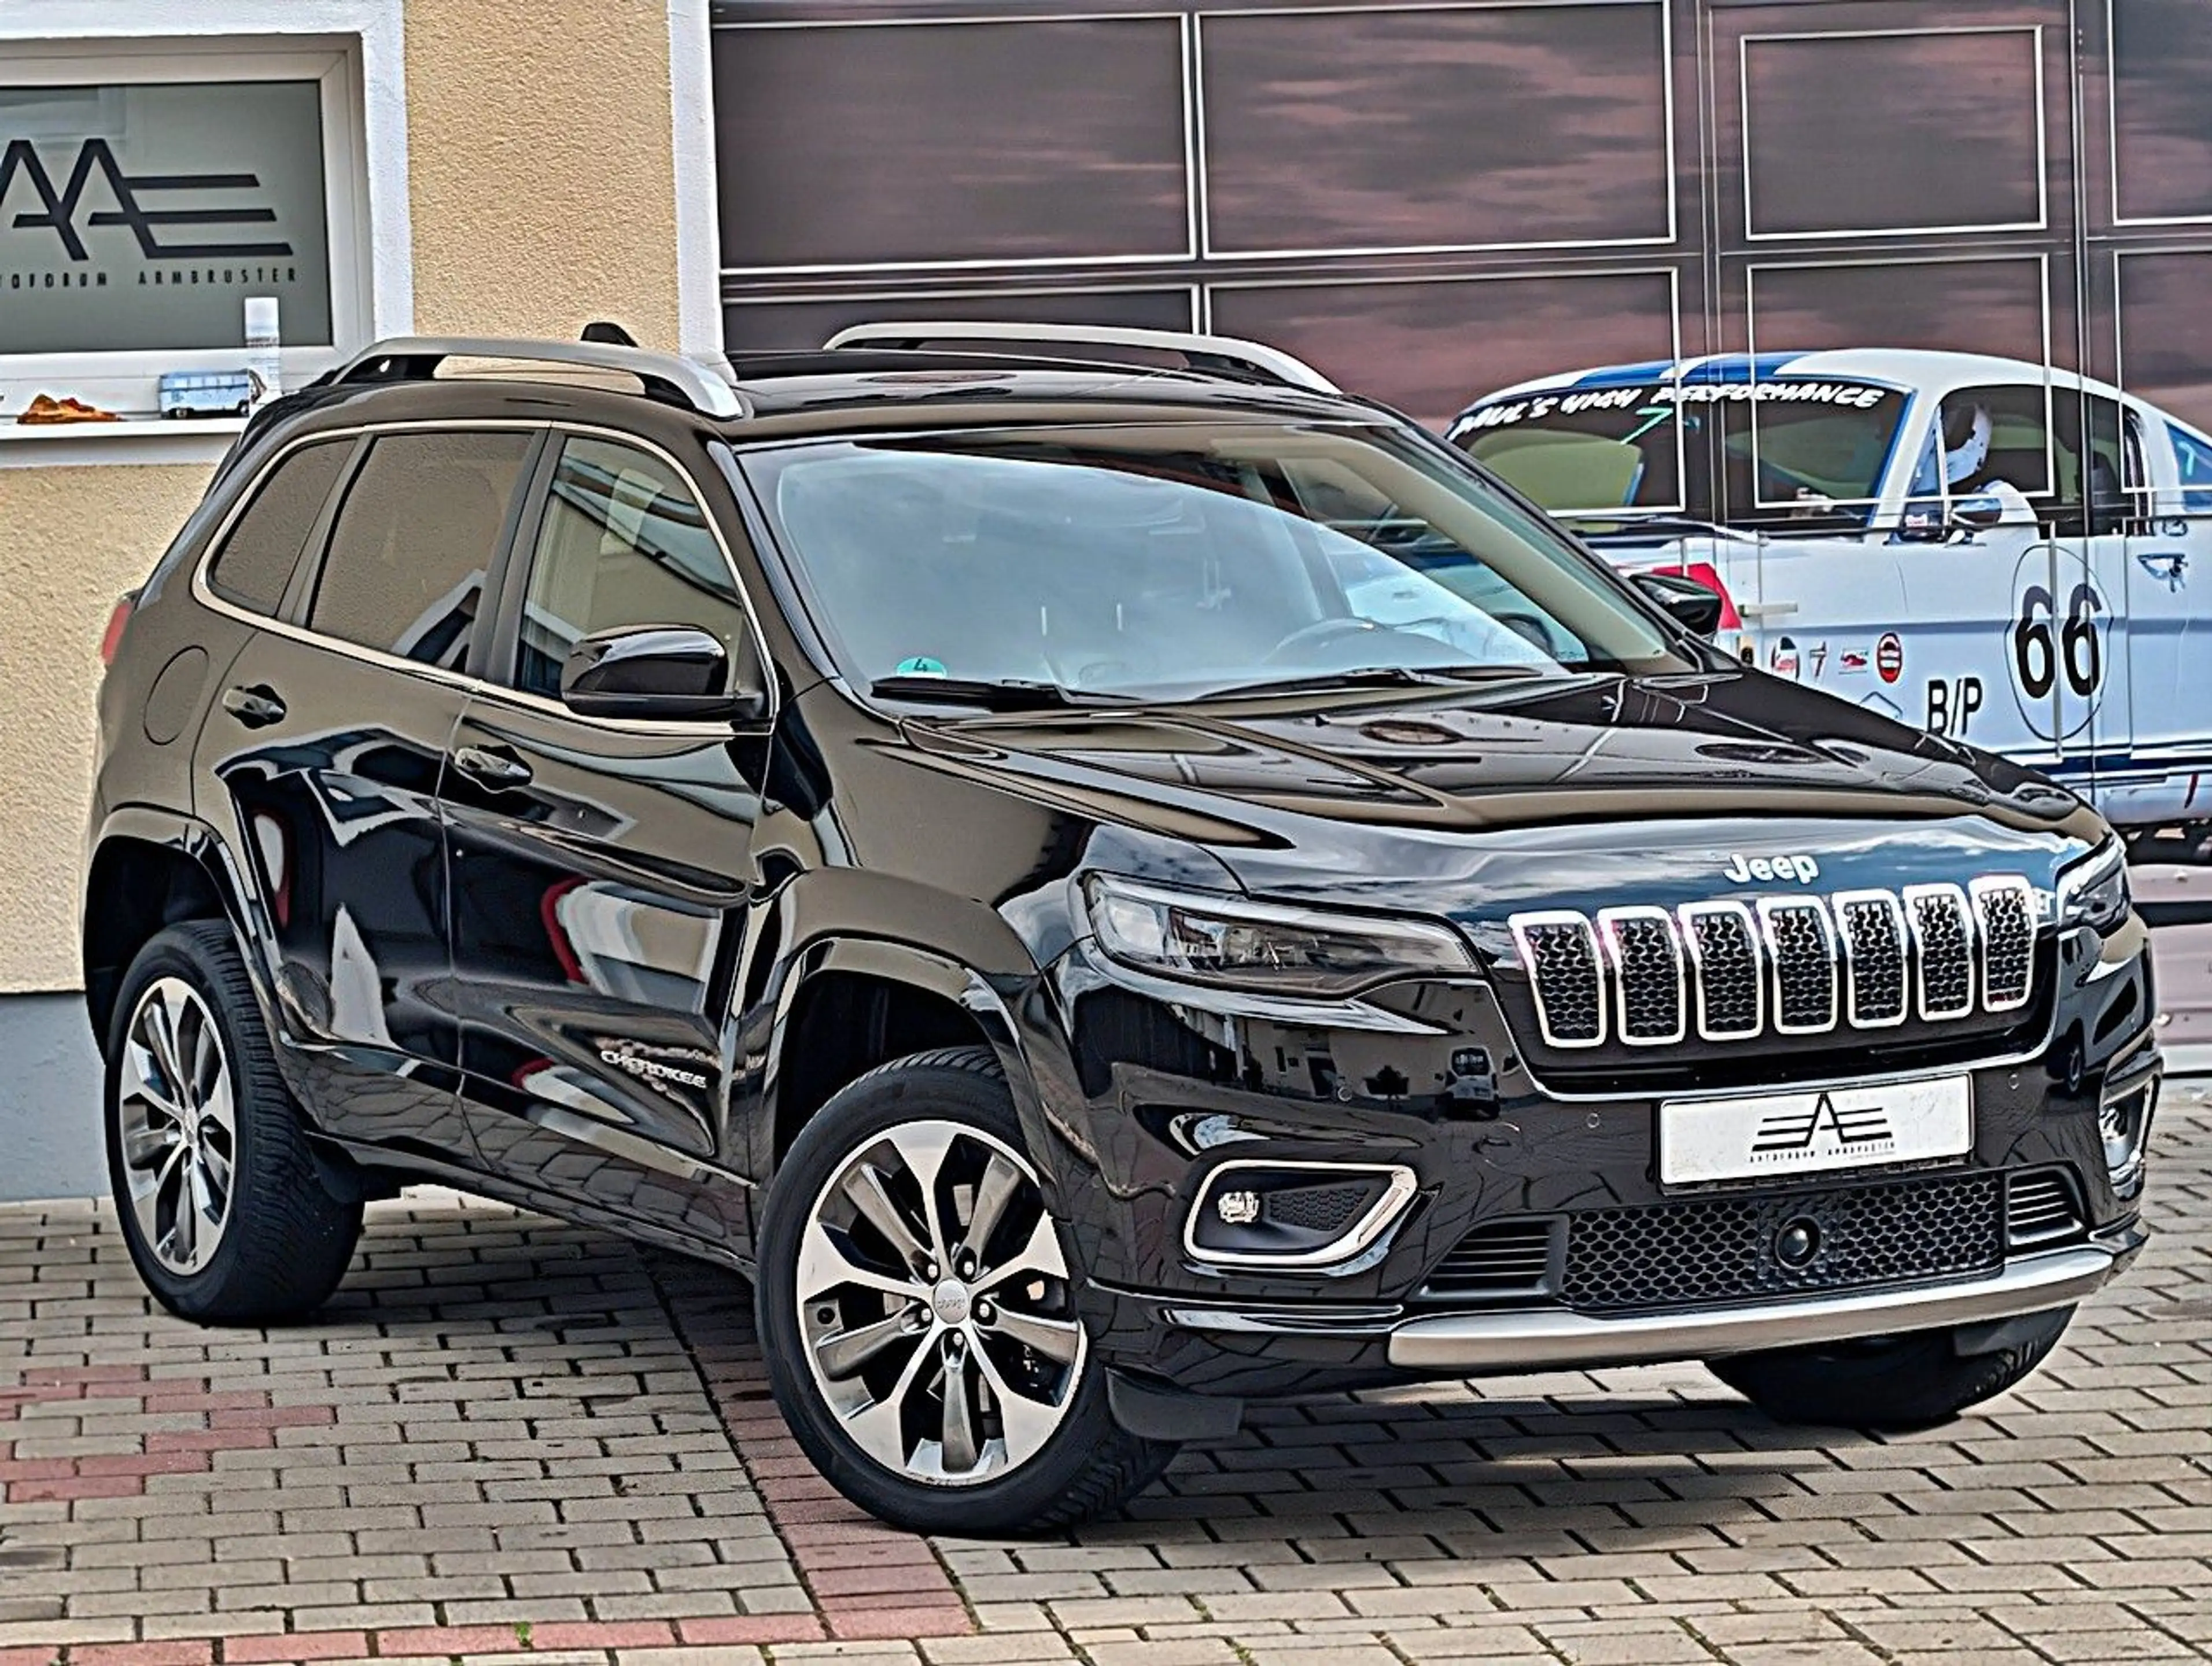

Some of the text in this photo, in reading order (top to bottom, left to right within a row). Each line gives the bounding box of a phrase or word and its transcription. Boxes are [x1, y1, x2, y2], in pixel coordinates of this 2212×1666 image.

[0, 267, 296, 288] OFORUM ARMBRUSTER
[1650, 382, 1885, 408] PERFORMANCE
[2015, 583, 2102, 699] 66
[913, 658, 928, 672] 4
[1927, 677, 1983, 737] B/P
[1722, 853, 1820, 884] Jeep
